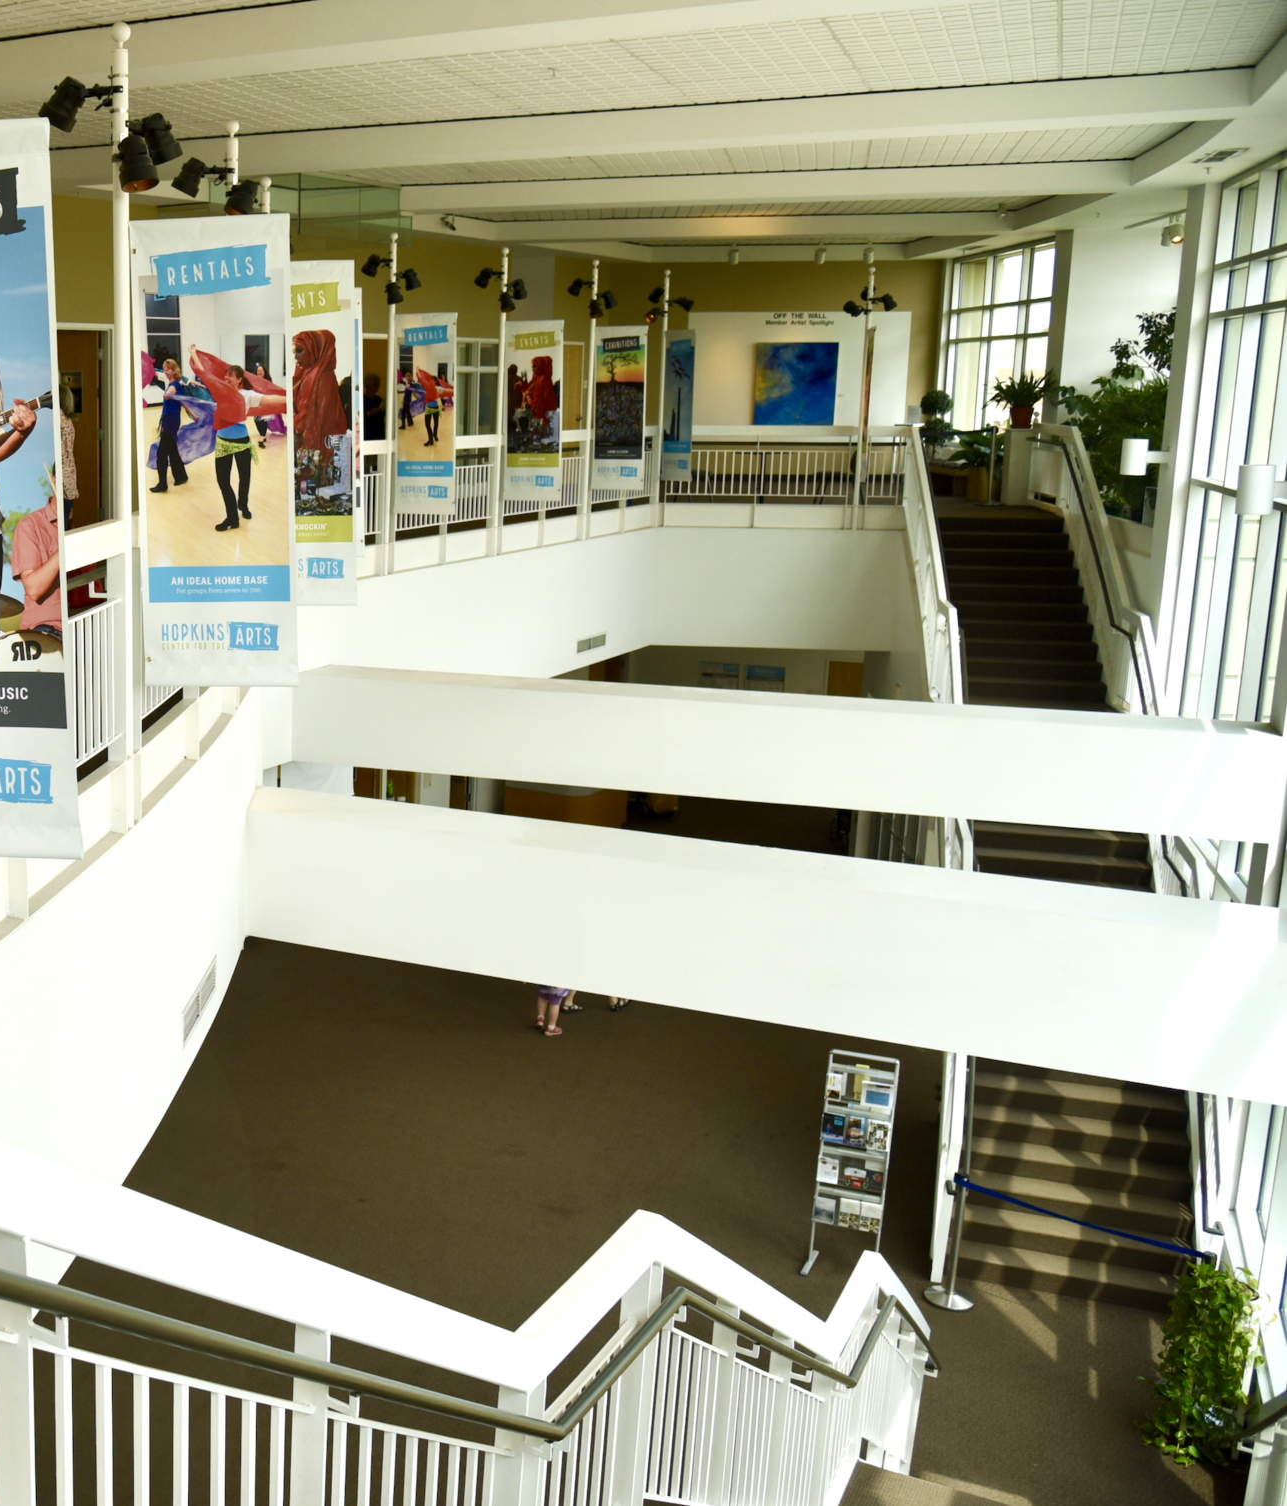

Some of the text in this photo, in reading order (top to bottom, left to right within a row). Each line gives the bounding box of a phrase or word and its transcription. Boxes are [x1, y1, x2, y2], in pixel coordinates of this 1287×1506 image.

[167, 256, 255, 287] RENTALS
[291, 290, 326, 310] NTS
[408, 330, 444, 343] RENTALS
[519, 335, 549, 348] EVENTS
[604, 338, 638, 350] EXHIBITIONS
[430, 487, 446, 497] ARTS
[311, 561, 339, 576] ARTS
[170, 575, 268, 586] AN IDEAL HOME BASE
[161, 623, 225, 642] HOPKINS
[235, 627, 272, 646] ARTS
[161, 642, 225, 651] CENTER FOR THE
